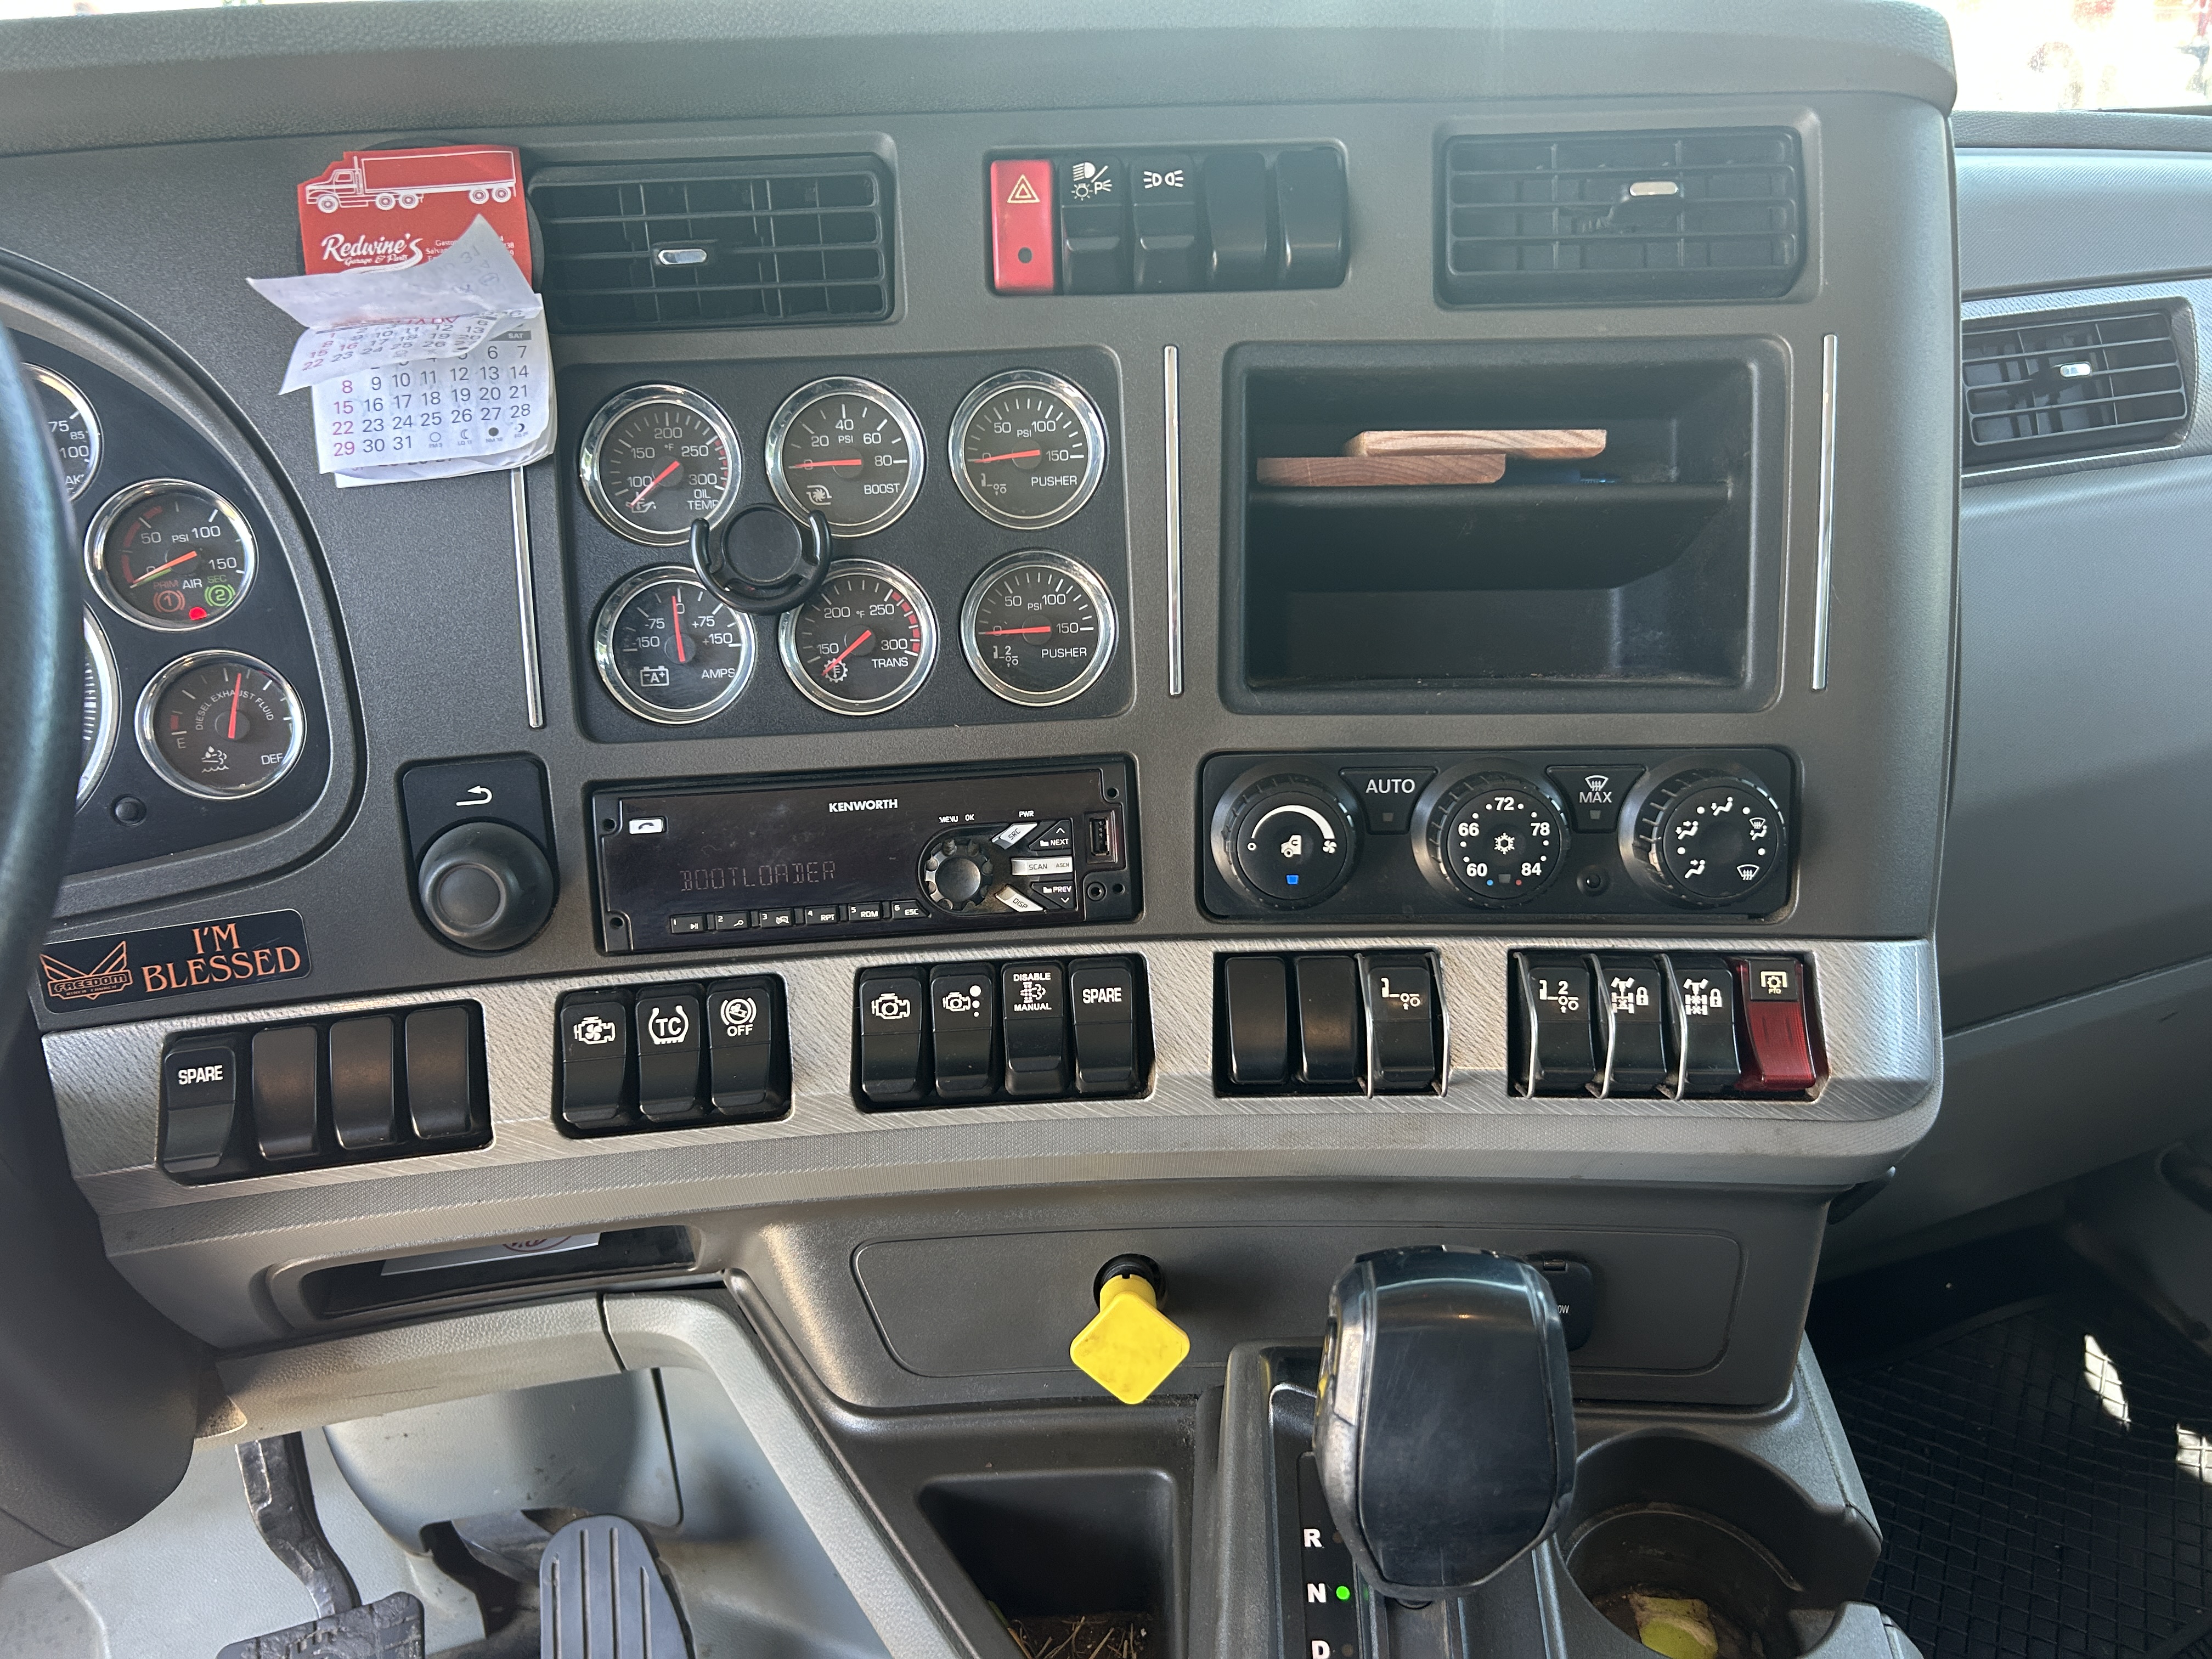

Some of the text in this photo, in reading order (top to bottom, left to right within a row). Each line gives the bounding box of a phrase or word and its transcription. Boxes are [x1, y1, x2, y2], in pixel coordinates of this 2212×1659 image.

[321, 233, 424, 266] Redwine's
[344, 253, 408, 267] Garage & Parts
[302, 358, 324, 371] 22
[331, 351, 354, 363] 23
[359, 347, 383, 355] 24
[390, 341, 413, 350] 25
[311, 349, 328, 359] 15
[488, 345, 527, 359] 6 7
[342, 365, 529, 394] 8 9 10 11 12 13 14
[334, 385, 528, 415] 15 16 17 18 19 20 21
[48, 420, 70, 432] 75
[332, 404, 531, 436] 22 23 24 25 26 27 28
[835, 419, 854, 431] 40
[1031, 420, 1057, 432] 100
[654, 427, 683, 439] 200
[994, 421, 1012, 433] 50
[70, 431, 85, 440] 85
[838, 435, 854, 444] PSI
[863, 432, 882, 445] 60
[1017, 429, 1032, 438] PSI
[334, 436, 412, 456] 29 30 31
[811, 435, 830, 447] 20
[59, 445, 89, 459] 100
[631, 447, 656, 459] 150
[681, 445, 709, 458] 250
[1046, 449, 1069, 461] 150
[874, 455, 893, 466] 80
[627, 476, 653, 488] 100
[689, 473, 718, 486] 300
[1031, 475, 1078, 487] PUSHER
[693, 489, 712, 499] OIL
[864, 483, 900, 495] BOOST
[687, 500, 720, 511] TEMP
[140, 532, 161, 544] 50
[192, 525, 221, 539] 100
[171, 534, 189, 543] PSI
[208, 557, 238, 570] 150
[153, 579, 179, 589] PRIM
[182, 578, 203, 590] AIR
[207, 575, 228, 584] SEC
[215, 589, 226, 601] 2
[1005, 595, 1022, 607] 50
[1041, 594, 1066, 605] 100
[823, 606, 851, 619] 200
[869, 603, 895, 616] 250
[1027, 602, 1042, 611] PSI
[644, 618, 665, 630] -75
[691, 616, 716, 628] +75
[1056, 622, 1079, 634] 150
[631, 636, 661, 648] -150
[702, 632, 733, 645] +150
[881, 638, 909, 651] 300
[816, 642, 839, 654] 150
[1041, 647, 1088, 659] PUSHER
[871, 657, 909, 668] TRANS
[701, 668, 736, 679] AMPS
[195, 702, 212, 731] DIESEL
[255, 697, 274, 721] FLUID
[177, 737, 187, 749] E
[261, 752, 284, 765] DEF
[1365, 778, 1415, 794] AUTO
[1578, 791, 1612, 804] MAX
[828, 798, 899, 813] KENWORTH
[1494, 797, 1515, 811] 72
[939, 815, 958, 823] MENU
[1008, 827, 1021, 840] SRC
[1458, 822, 1480, 837] 66
[1530, 822, 1550, 837] 78
[1050, 838, 1069, 846] NEXT
[1466, 863, 1488, 877] 60
[1521, 862, 1542, 877] 84
[679, 860, 836, 892] BOOTLOADER
[1052, 885, 1072, 893] PREV
[1012, 897, 1029, 909] DISP
[820, 913, 835, 922] RPT
[860, 910, 879, 918] RDM
[904, 908, 919, 916] ESC
[192, 923, 241, 955] I'M
[140, 945, 301, 993] BLESSED
[54, 974, 127, 992] FREEDOM
[1013, 972, 1052, 982] DISABLE
[1082, 988, 1122, 1004] SPARE
[1013, 1002, 1052, 1012] MANUAL
[655, 1017, 682, 1036] TC
[726, 1024, 753, 1037] OFF
[178, 1065, 223, 1085] SPARE
[1303, 1528, 1323, 1548] R
[1307, 1583, 1327, 1603] N
[1312, 1640, 1330, 1659] D
